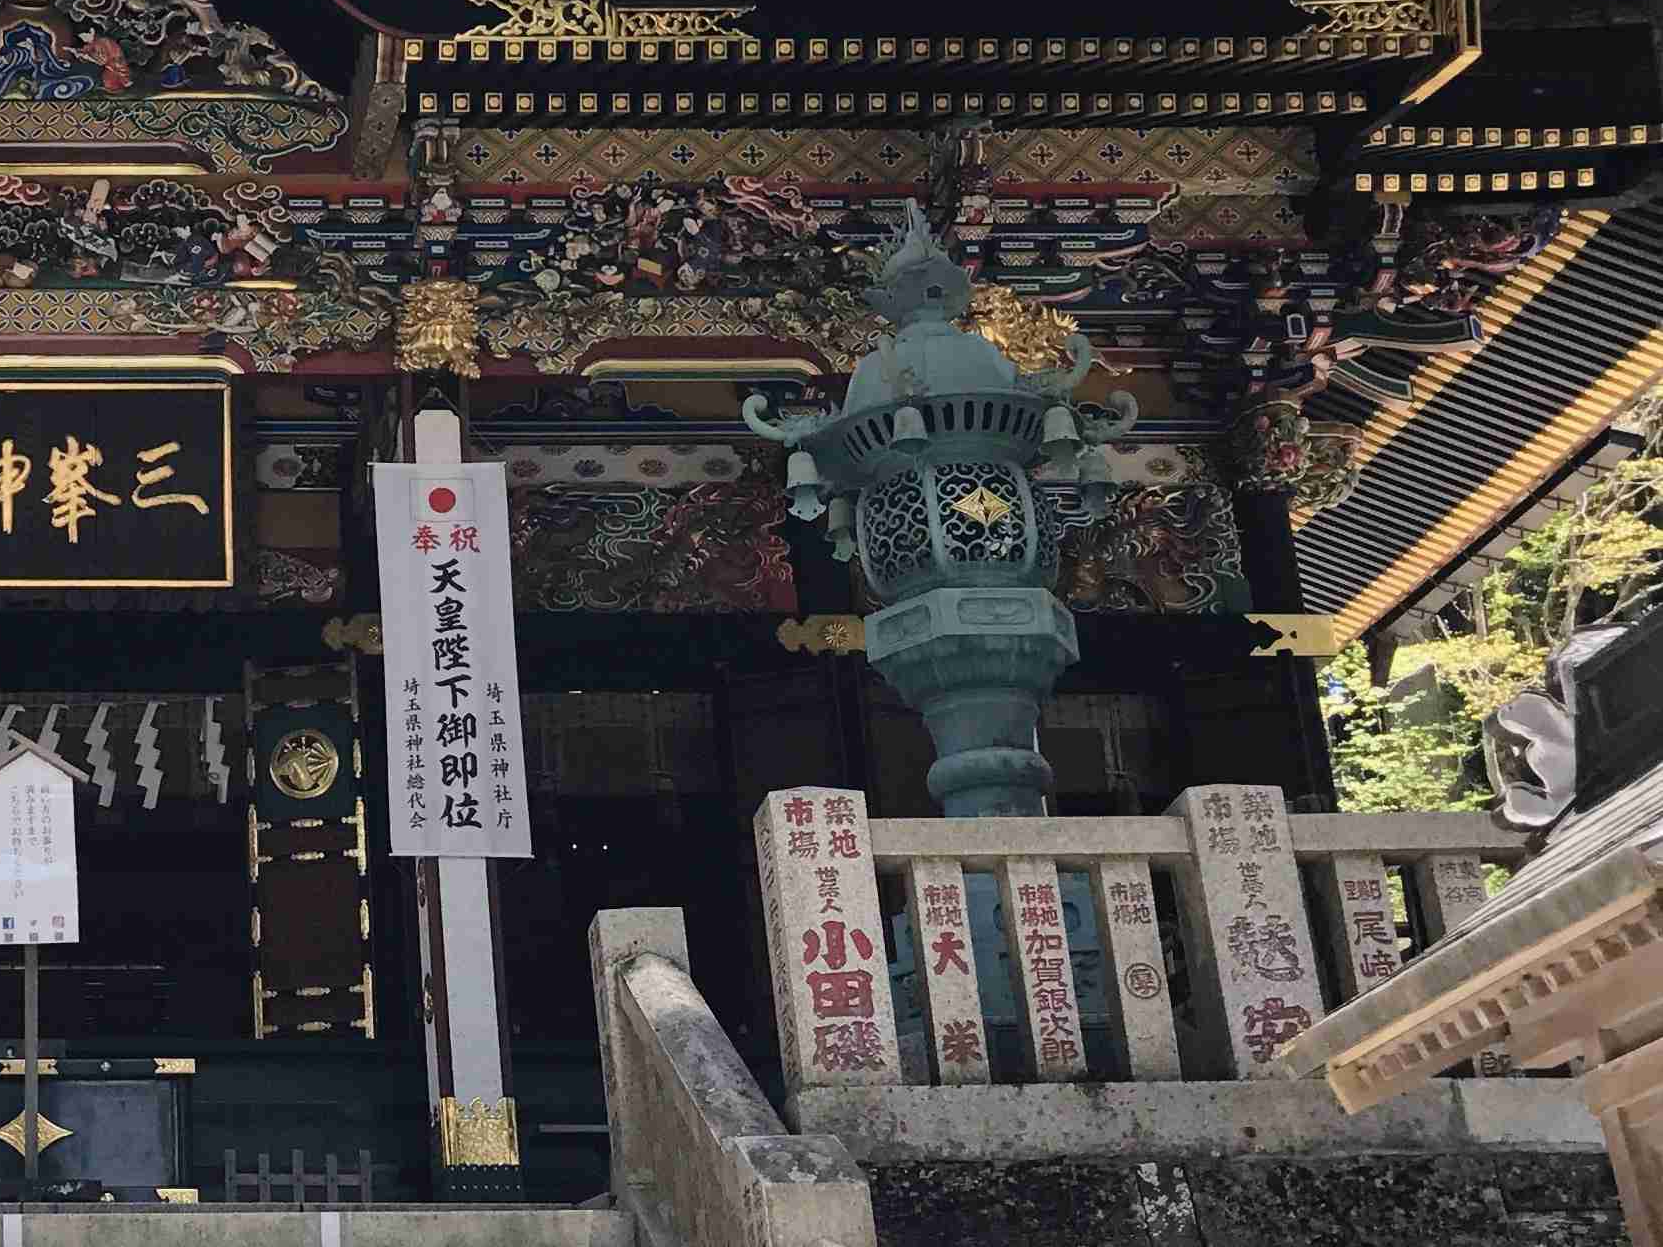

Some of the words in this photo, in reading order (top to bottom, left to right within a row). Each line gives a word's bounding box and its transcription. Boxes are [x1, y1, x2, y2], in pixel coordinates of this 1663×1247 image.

[411, 525, 482, 554] 奉祝
[429, 558, 483, 830] 天皇陛下御即位
[486, 682, 513, 829] 埼玉県神社庁
[823, 796, 861, 859] 築地
[931, 931, 982, 1064] 大栄
[1025, 929, 1079, 1064] 加賀銀次郎
